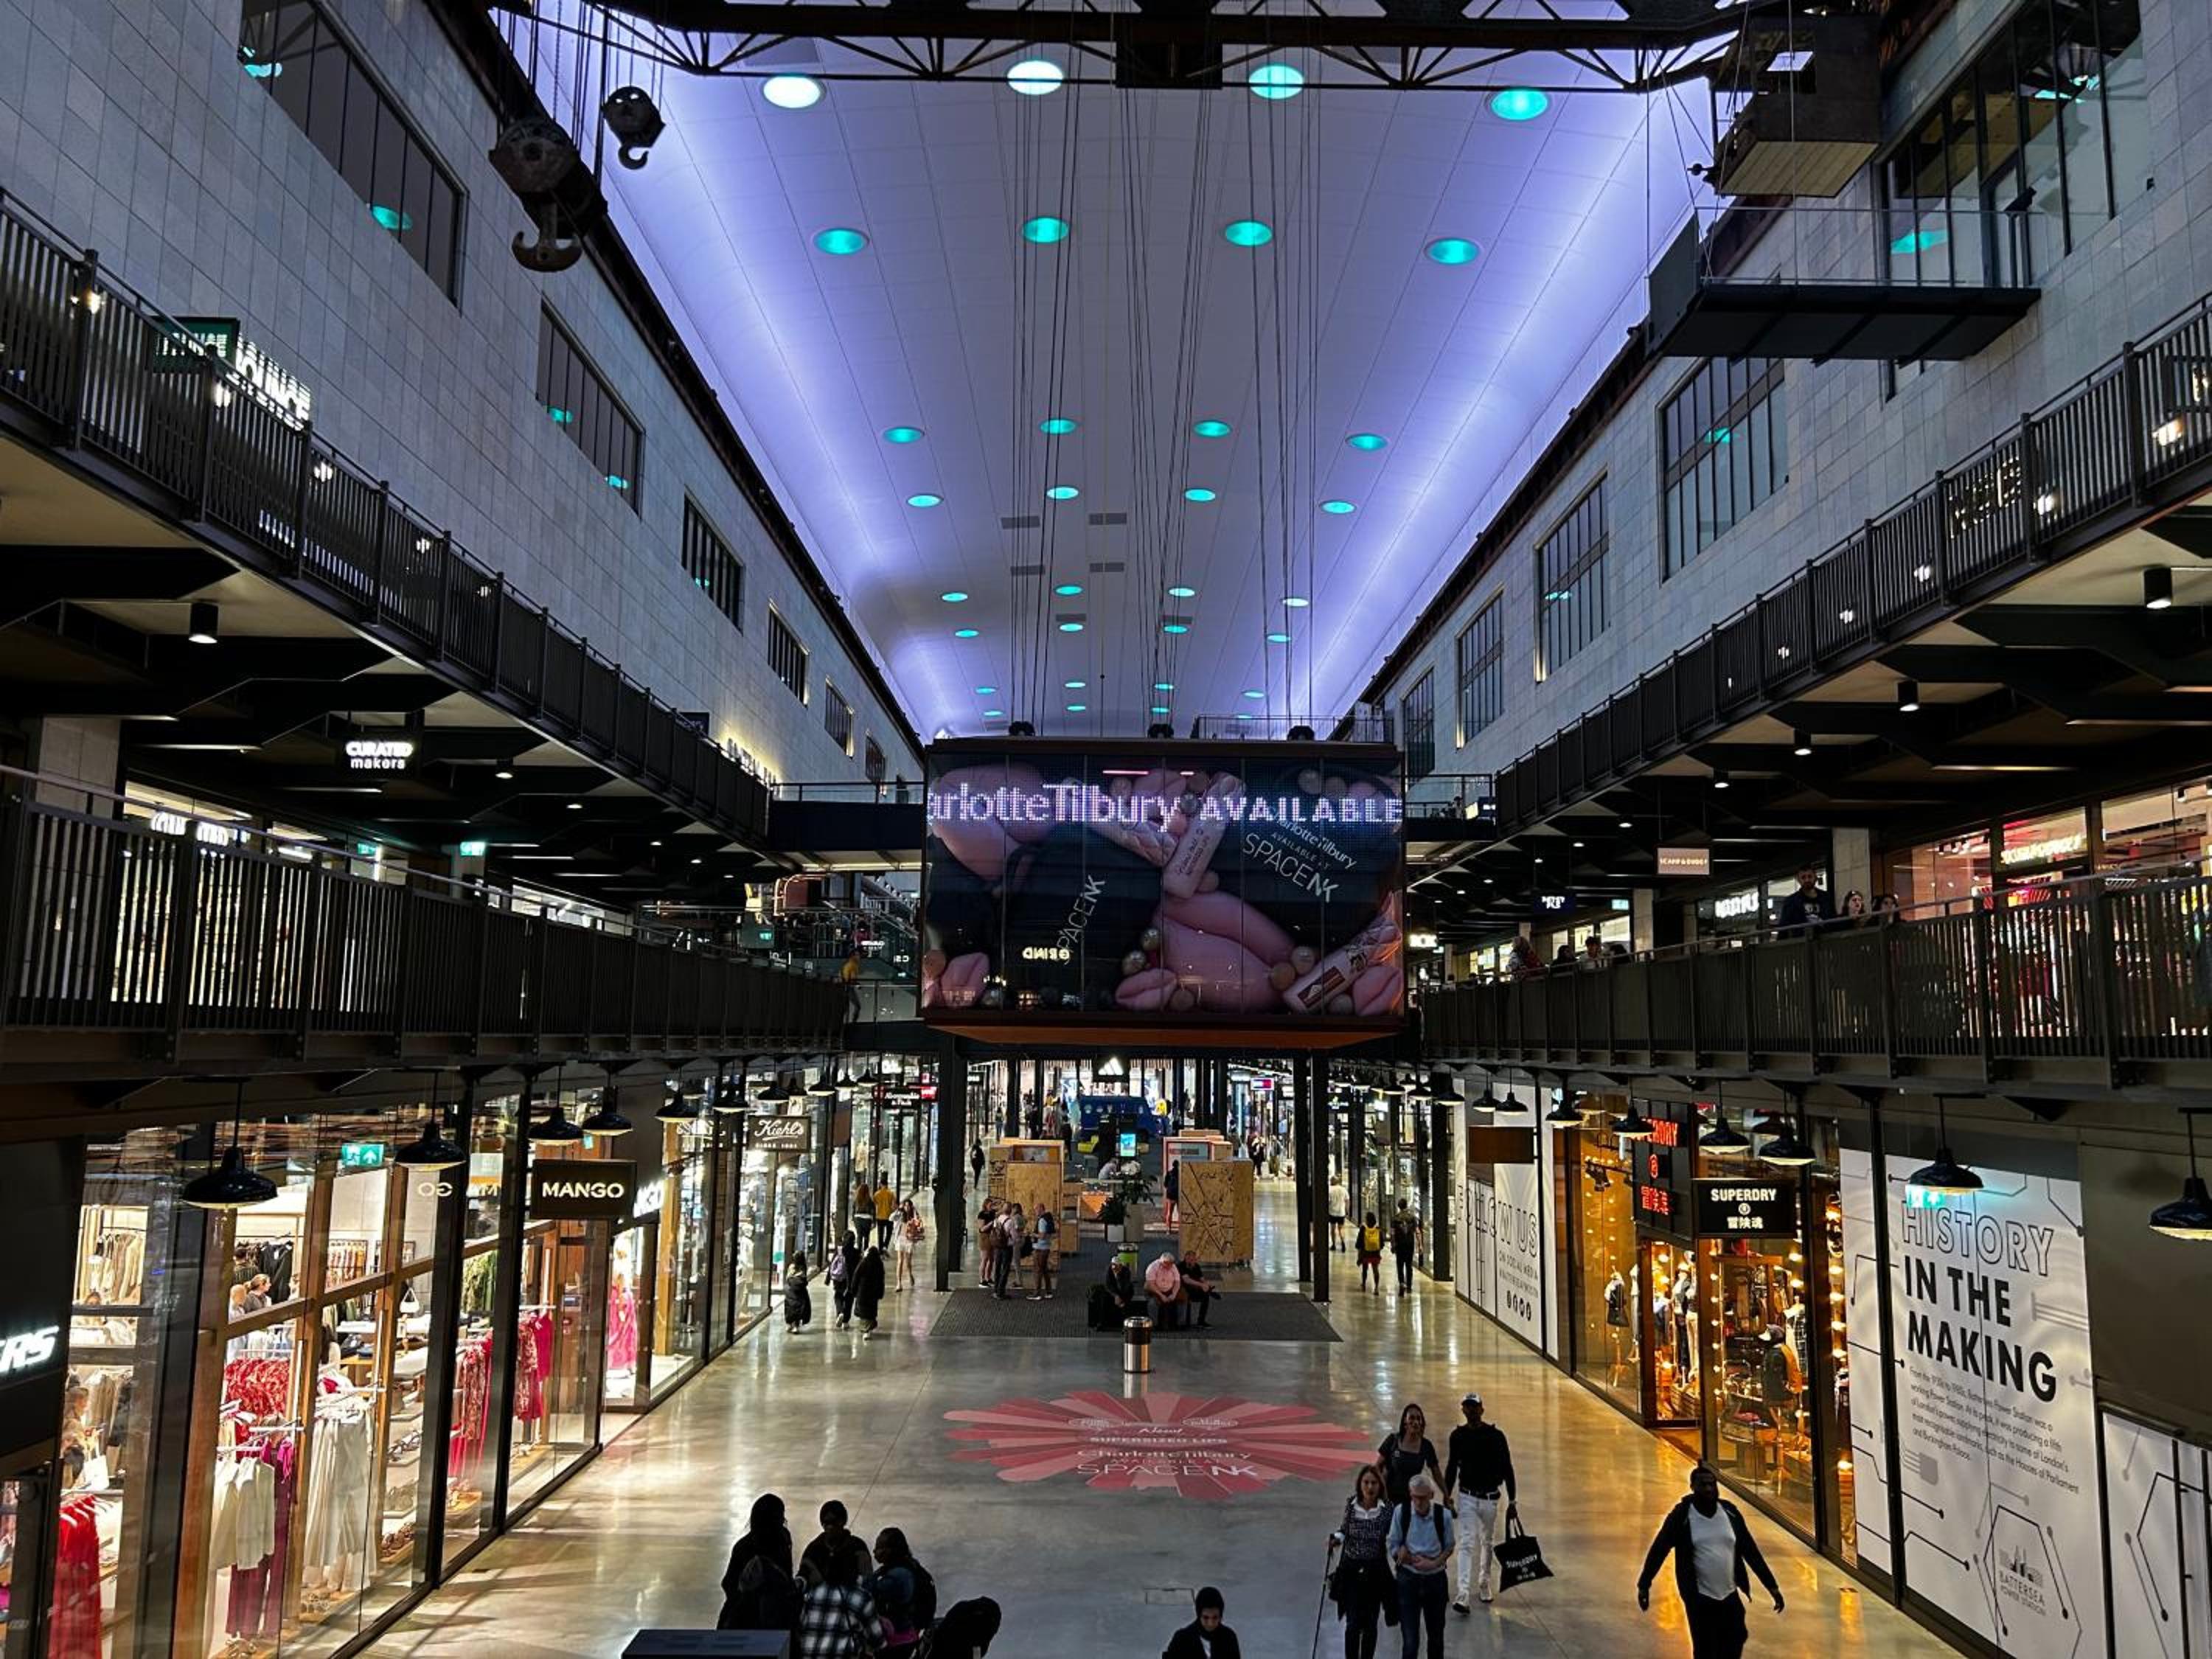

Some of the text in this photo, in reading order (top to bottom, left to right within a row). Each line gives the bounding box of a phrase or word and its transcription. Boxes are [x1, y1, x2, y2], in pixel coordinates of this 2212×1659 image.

[1200, 797, 1403, 823] AVAILABLE
[754, 1119, 804, 1136] Kiehl's
[542, 1182, 625, 1199] MANGO
[1710, 1188, 1777, 1201] SUPERDRY
[1902, 1200, 2054, 1277] HISTORY
[1905, 1255, 2011, 1328] IN THE
[1907, 1310, 2057, 1402] MAKING
[2013, 1405, 2032, 1423] Station
[2034, 1419, 2046, 1430] was
[2000, 1422, 2011, 1432] was
[2012, 1426, 2043, 1448] producing
[2015, 1443, 2031, 1457] some
[2040, 1450, 2069, 1473] London's
[2006, 1453, 2014, 1466] the
[2015, 1456, 2037, 1475] Houses
[2046, 1469, 2079, 1495] Parliament
[1999, 1569, 2046, 1607] BATTERSEA
